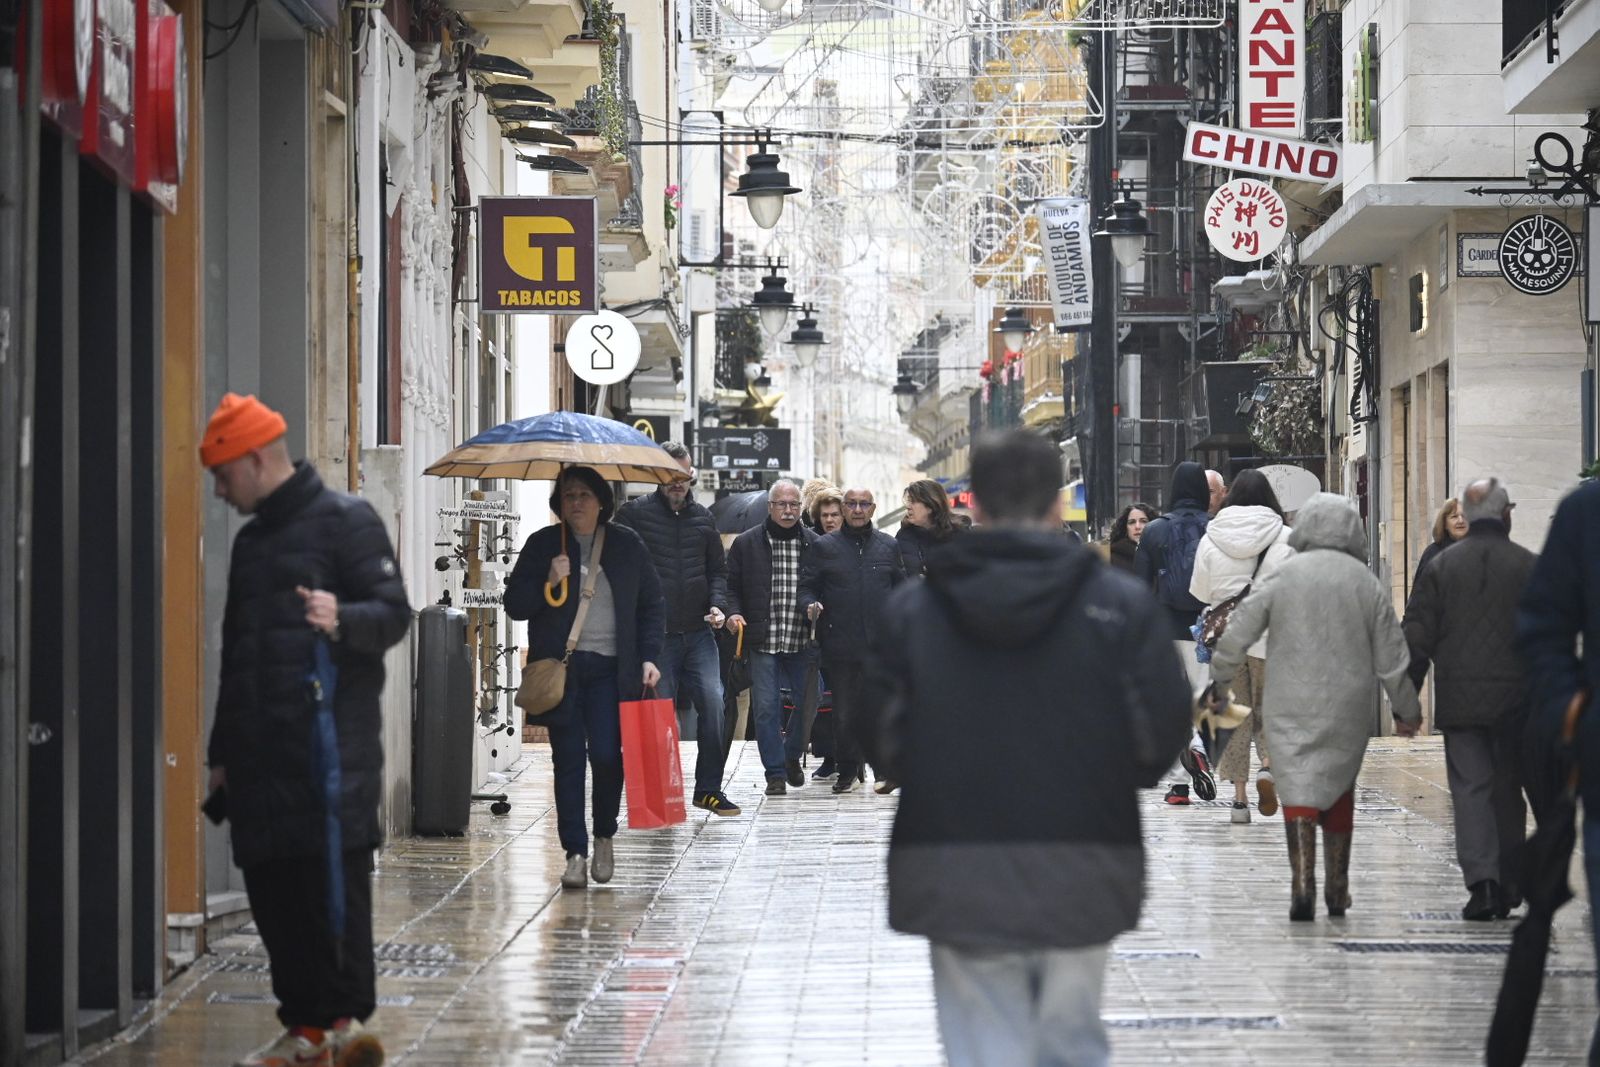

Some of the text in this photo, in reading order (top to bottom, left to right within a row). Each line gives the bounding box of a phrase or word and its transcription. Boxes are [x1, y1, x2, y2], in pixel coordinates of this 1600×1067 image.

[1249, 0, 1296, 128] ANTE
[1191, 129, 1338, 179] CHINO
[1043, 207, 1070, 219] HUELVA
[1208, 182, 1285, 229] PAIS DIVINO
[1046, 223, 1075, 306] ALQUILER DE
[1062, 220, 1089, 305] ANDAMIOS
[1507, 261, 1567, 288] MALAESQUINA
[497, 289, 581, 307] TABACOS
